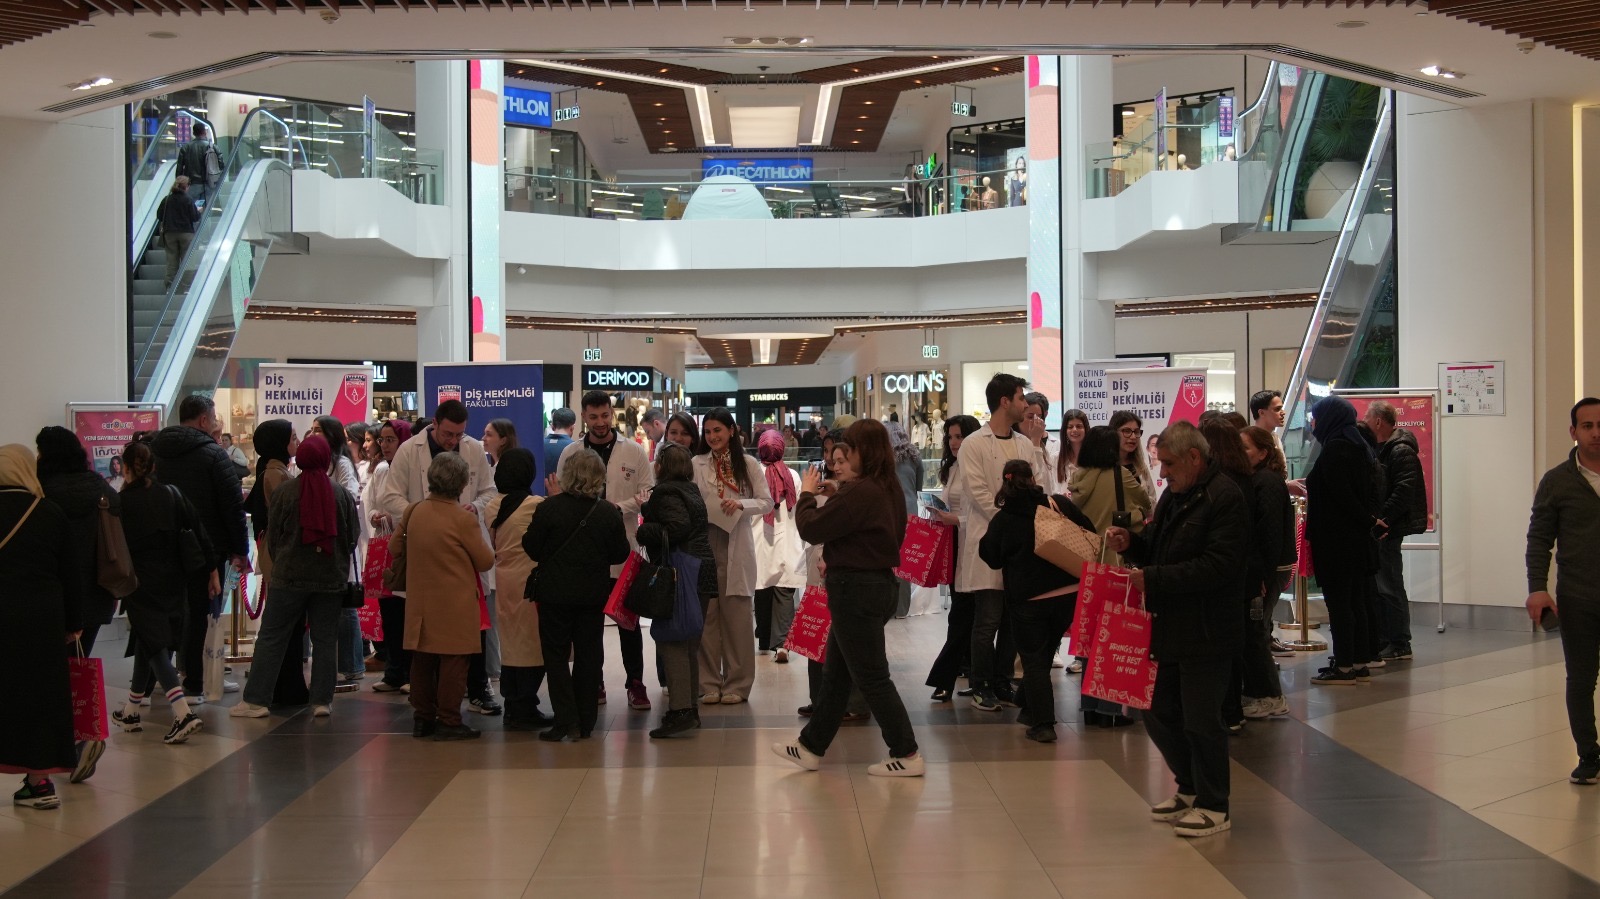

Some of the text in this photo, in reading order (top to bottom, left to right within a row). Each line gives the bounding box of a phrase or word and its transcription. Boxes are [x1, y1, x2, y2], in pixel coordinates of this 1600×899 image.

[504, 96, 549, 117] THLON
[726, 166, 811, 179] DECATHLON
[588, 368, 650, 386] DERİMOD
[1078, 369, 1107, 378] ALTINB
[265, 373, 284, 388] DİŞ
[884, 369, 945, 394] COLIN'S
[1078, 378, 1103, 389] KÖKLÜ
[1112, 378, 1129, 393] DİŞ
[265, 388, 323, 401] HEKİMLİĞİ
[465, 386, 535, 401] DİŞ HEKİMLİĞİ
[749, 392, 789, 402] STARBUCKS
[1112, 391, 1165, 406] HEKİMLİĞİ
[265, 402, 323, 415] FAKÜLTESİ
[465, 398, 508, 408] FAKÜLTESİ
[1078, 401, 1103, 412] GÜÇLÜ
[1088, 412, 1108, 421] LECE
[1112, 406, 1165, 420] ÜLTESİ
[1109, 643, 1133, 653] BRINGS
[1112, 653, 1143, 666] THE BEST
